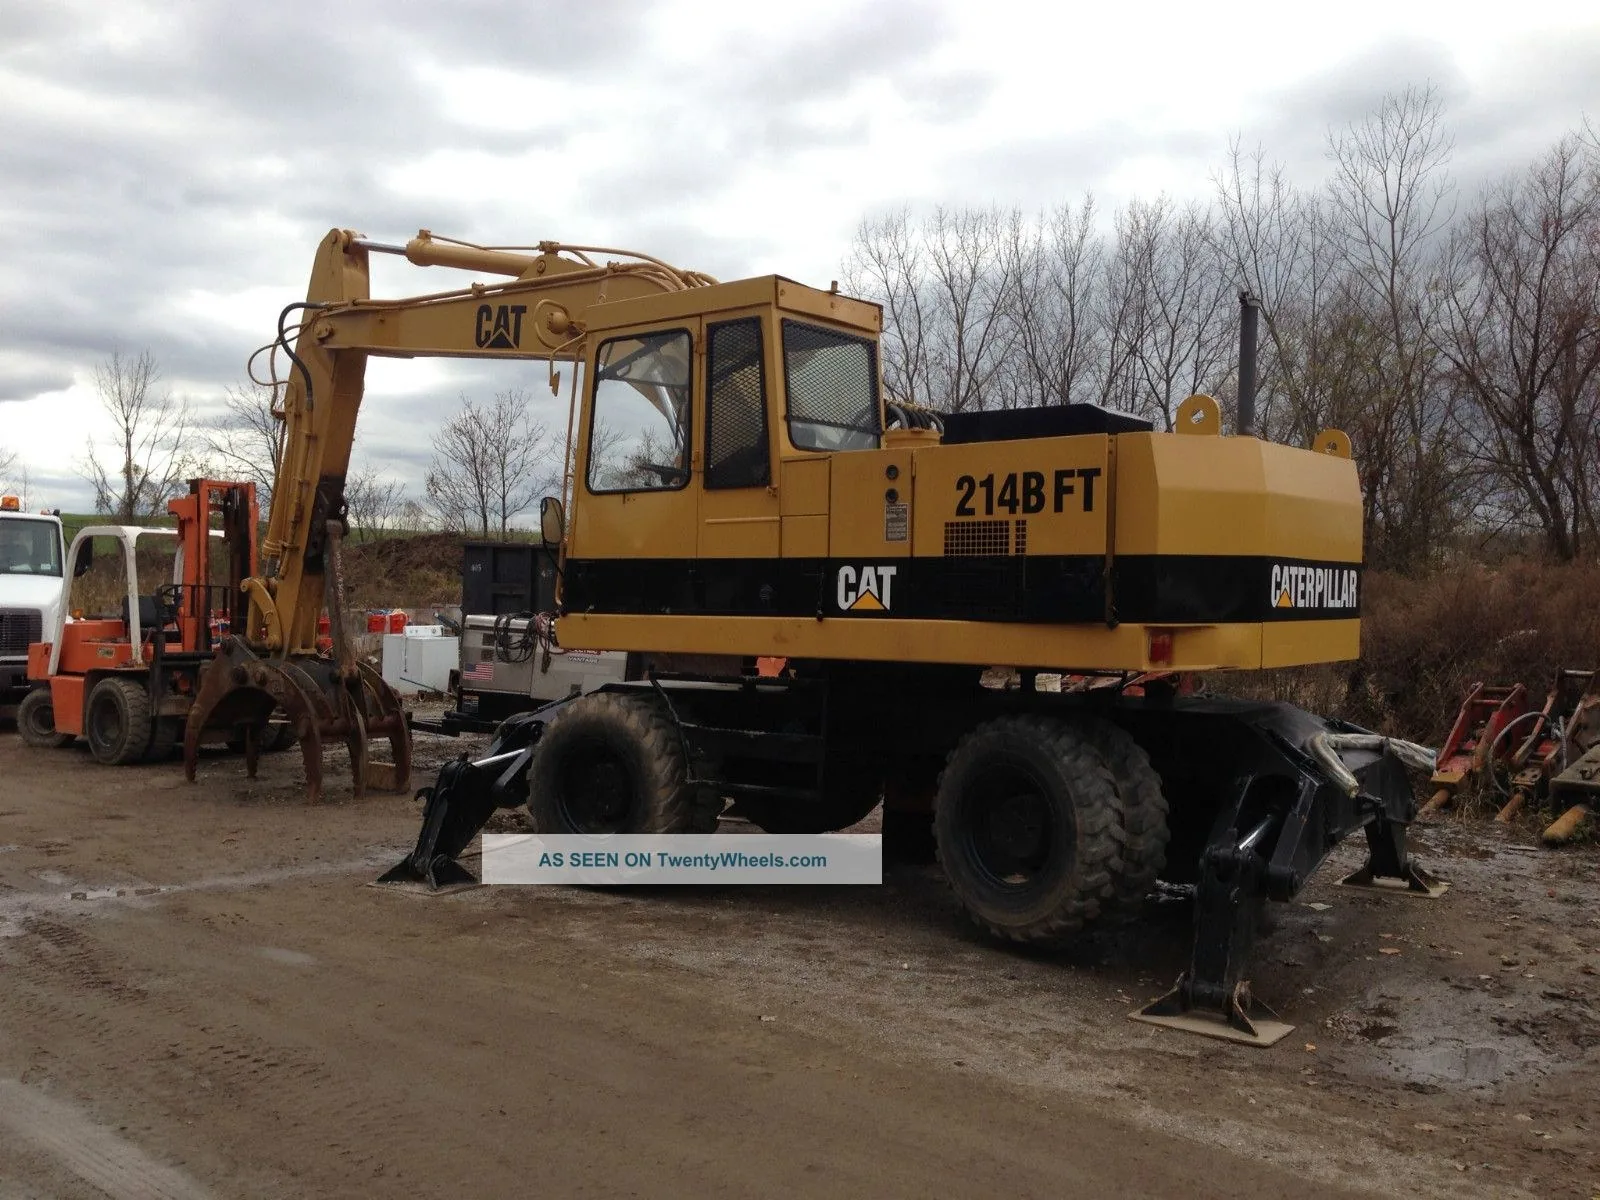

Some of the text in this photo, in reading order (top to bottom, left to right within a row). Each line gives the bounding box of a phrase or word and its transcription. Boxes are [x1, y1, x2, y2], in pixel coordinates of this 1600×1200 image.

[476, 304, 527, 349] CAT
[955, 467, 1101, 516] 214B FT
[837, 565, 897, 611] CAT
[1270, 564, 1358, 608] CATERPILLAR
